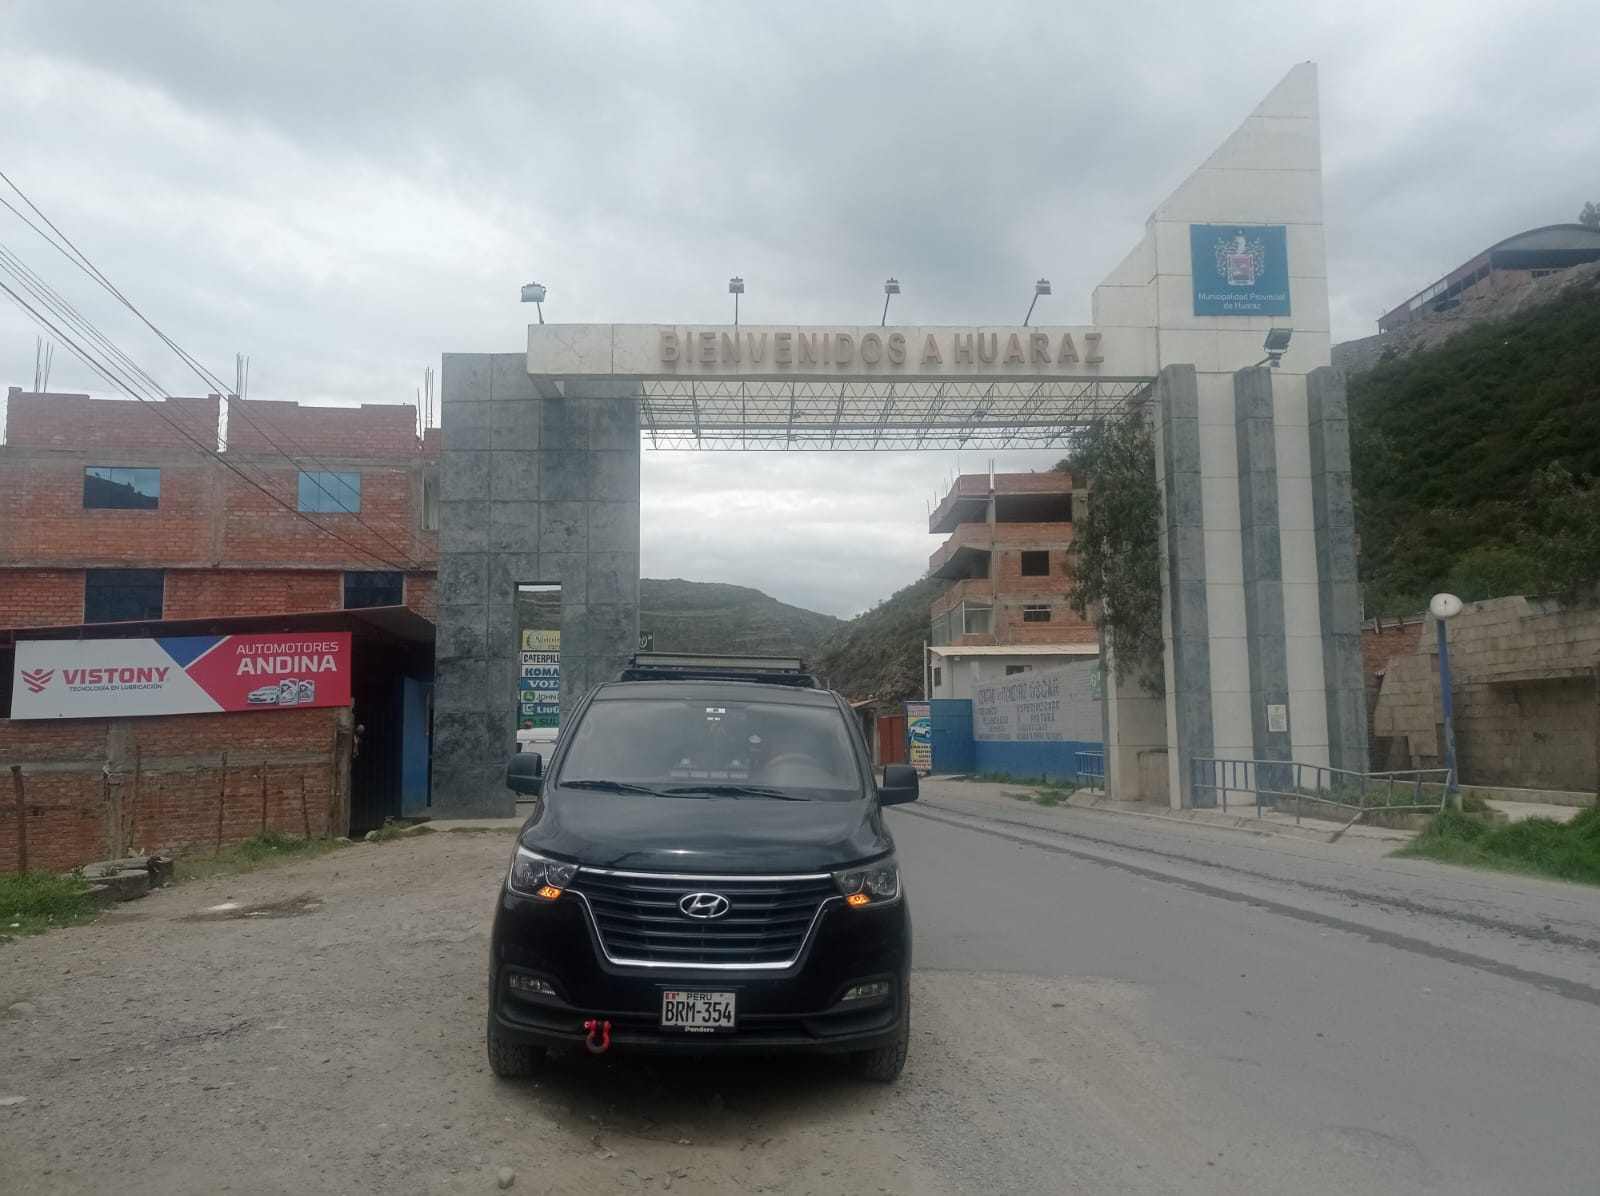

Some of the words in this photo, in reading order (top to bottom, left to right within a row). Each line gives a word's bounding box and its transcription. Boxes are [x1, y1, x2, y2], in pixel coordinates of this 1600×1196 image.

[1198, 293, 1248, 302] Municipalidad
[1250, 293, 1285, 301] Provincial
[1223, 302, 1233, 310] de
[1234, 302, 1261, 310] Huaraz
[660, 331, 907, 365] BIENVENIDOS
[920, 333, 943, 365] A
[953, 332, 1104, 365] HUARAZ
[236, 641, 339, 655] AUTOMOTORES
[236, 655, 337, 675] ANDINA
[62, 666, 170, 685] VISTONY
[686, 993, 713, 1001] PERU
[664, 1001, 732, 1023] BRM-354
